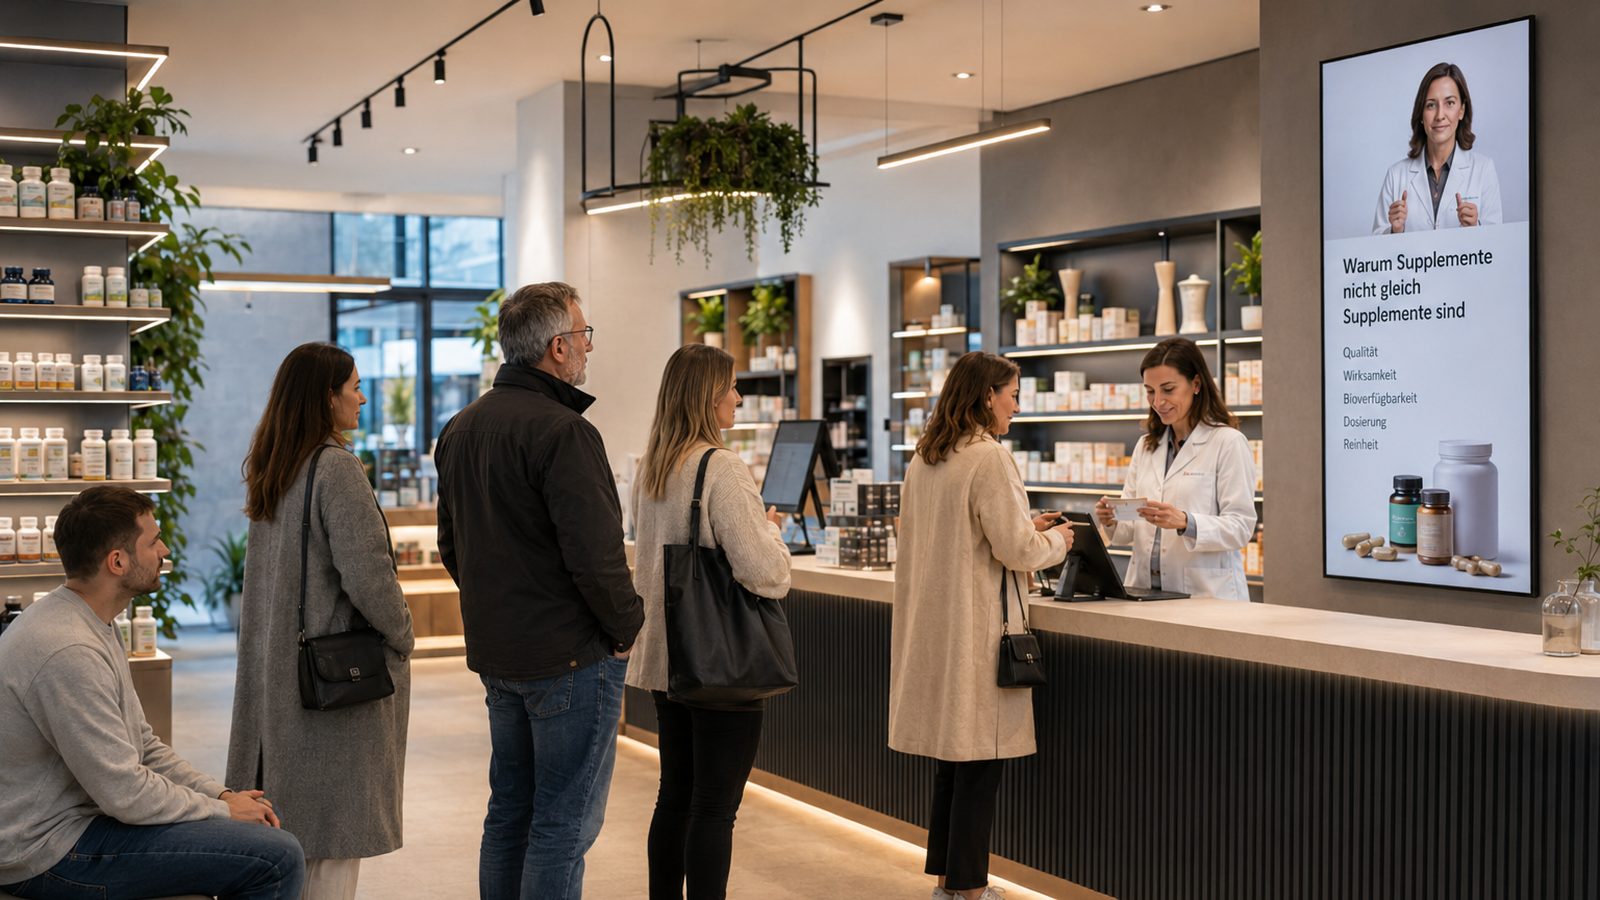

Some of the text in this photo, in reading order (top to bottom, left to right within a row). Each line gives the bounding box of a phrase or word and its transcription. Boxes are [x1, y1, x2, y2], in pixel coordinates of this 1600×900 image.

[1343, 250, 1493, 274] Warum Supplemente
[1343, 278, 1421, 300] nicht gleich
[1343, 301, 1465, 327] Supplemente sind
[1343, 346, 1378, 359] Qualität
[1343, 369, 1397, 381] Wirksamkeit
[1343, 392, 1417, 406] Bioverfügbarkeit
[1343, 416, 1387, 429] Dosierung
[1343, 439, 1378, 450] Reinheit
